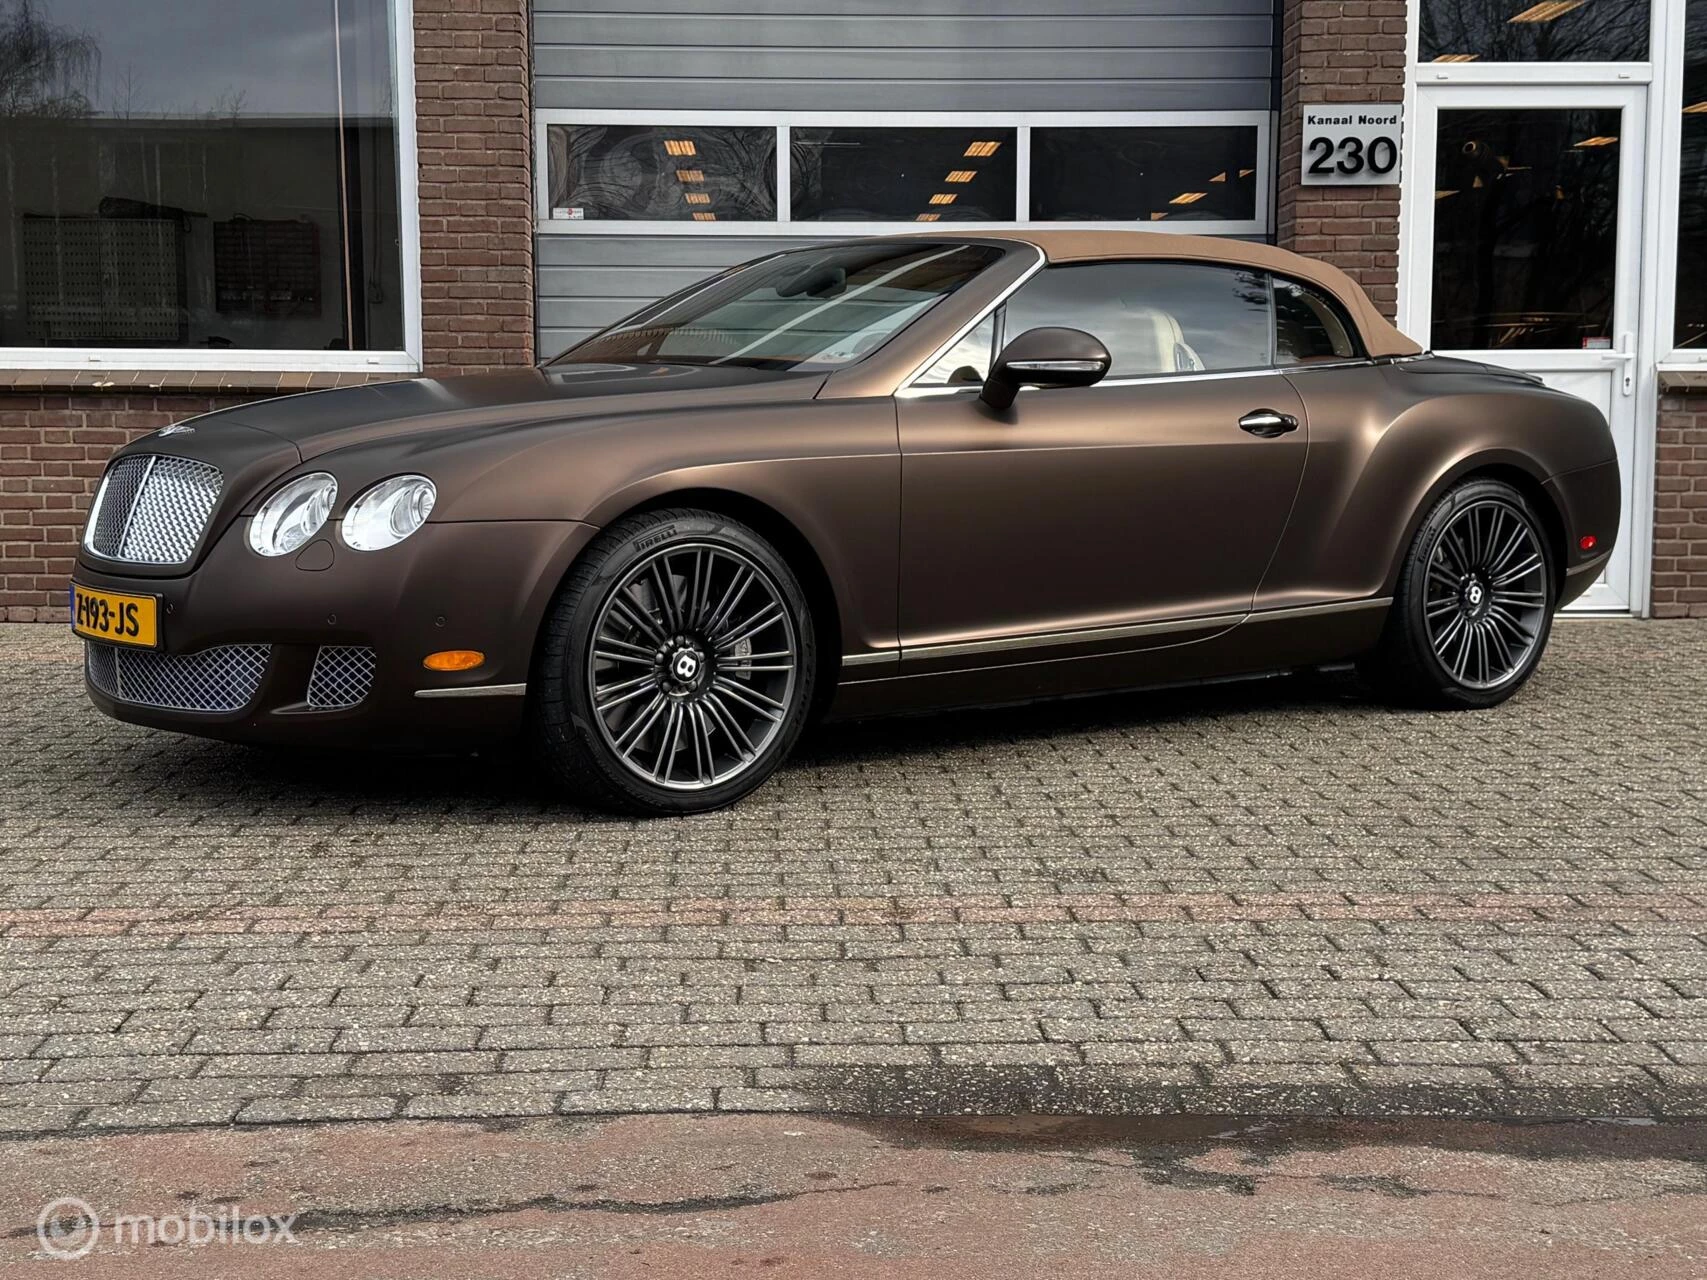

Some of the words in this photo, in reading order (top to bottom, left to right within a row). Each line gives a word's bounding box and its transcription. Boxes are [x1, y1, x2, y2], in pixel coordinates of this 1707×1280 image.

[1308, 115, 1353, 125] Kanaal
[1358, 115, 1397, 125] Noord
[1308, 136, 1398, 175] 230
[633, 524, 678, 552] PIRELLI
